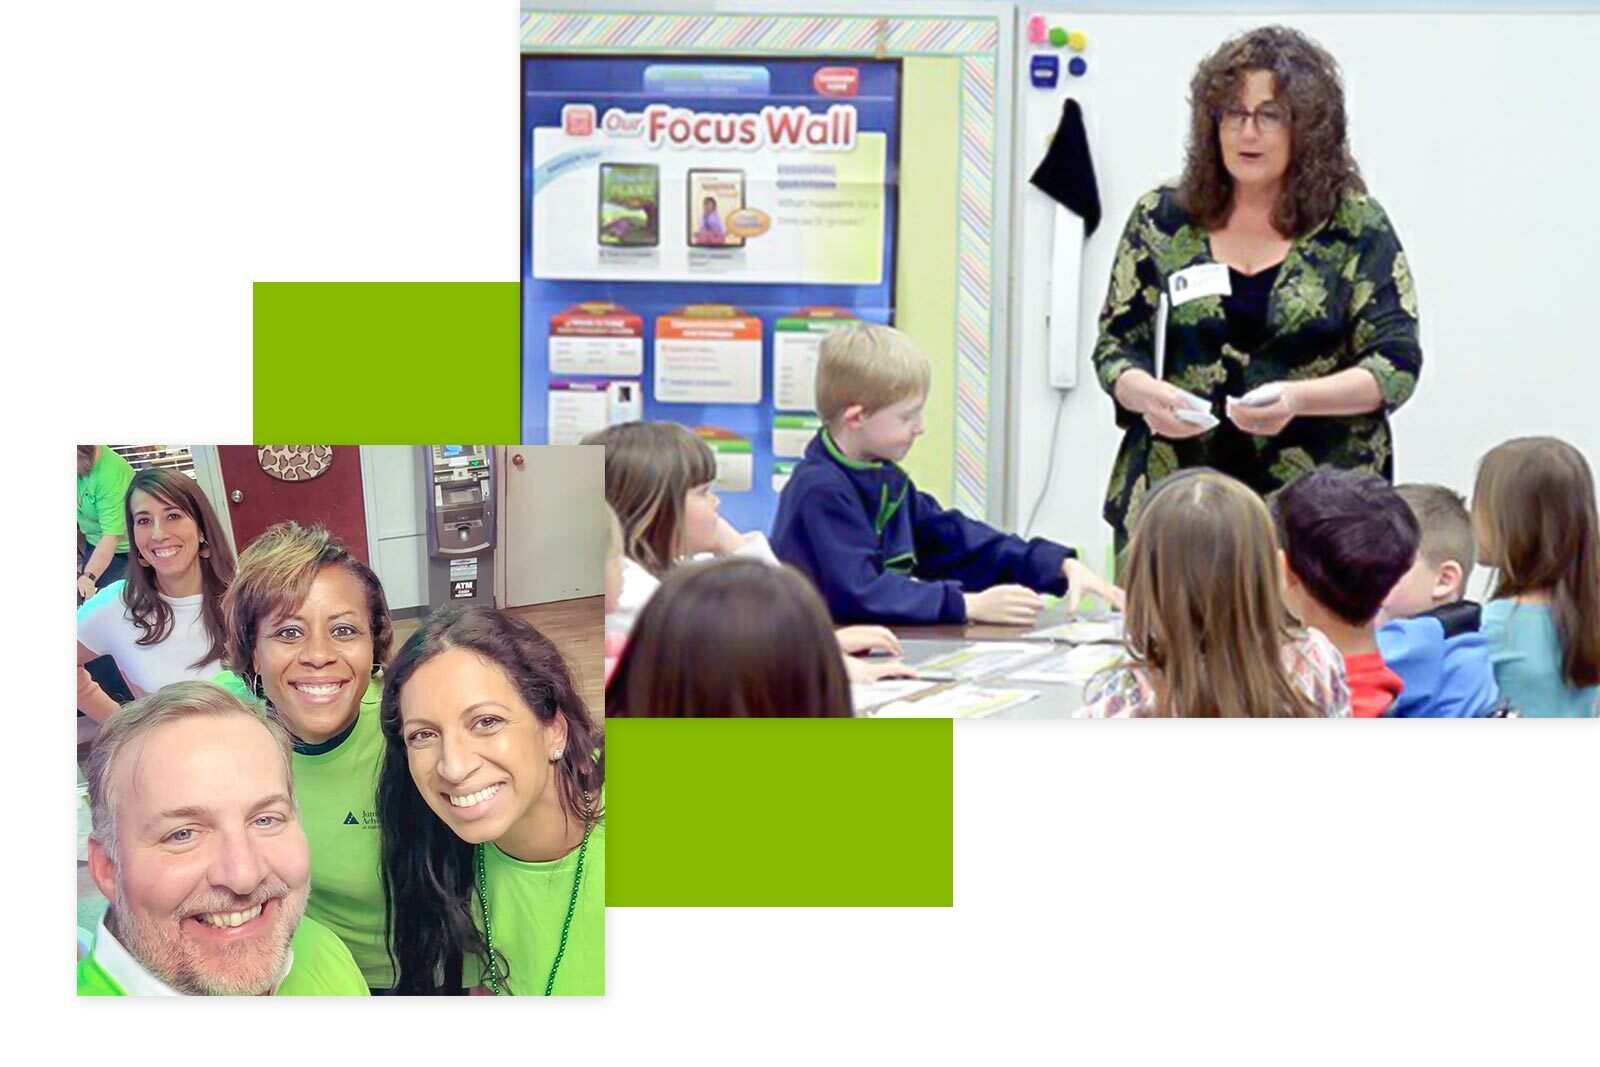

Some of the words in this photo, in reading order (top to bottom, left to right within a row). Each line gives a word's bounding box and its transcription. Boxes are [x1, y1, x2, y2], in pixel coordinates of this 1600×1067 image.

[606, 112, 643, 132] Our
[649, 110, 756, 145] Focus
[765, 110, 851, 145] Wall
[455, 582, 473, 590] ATM
